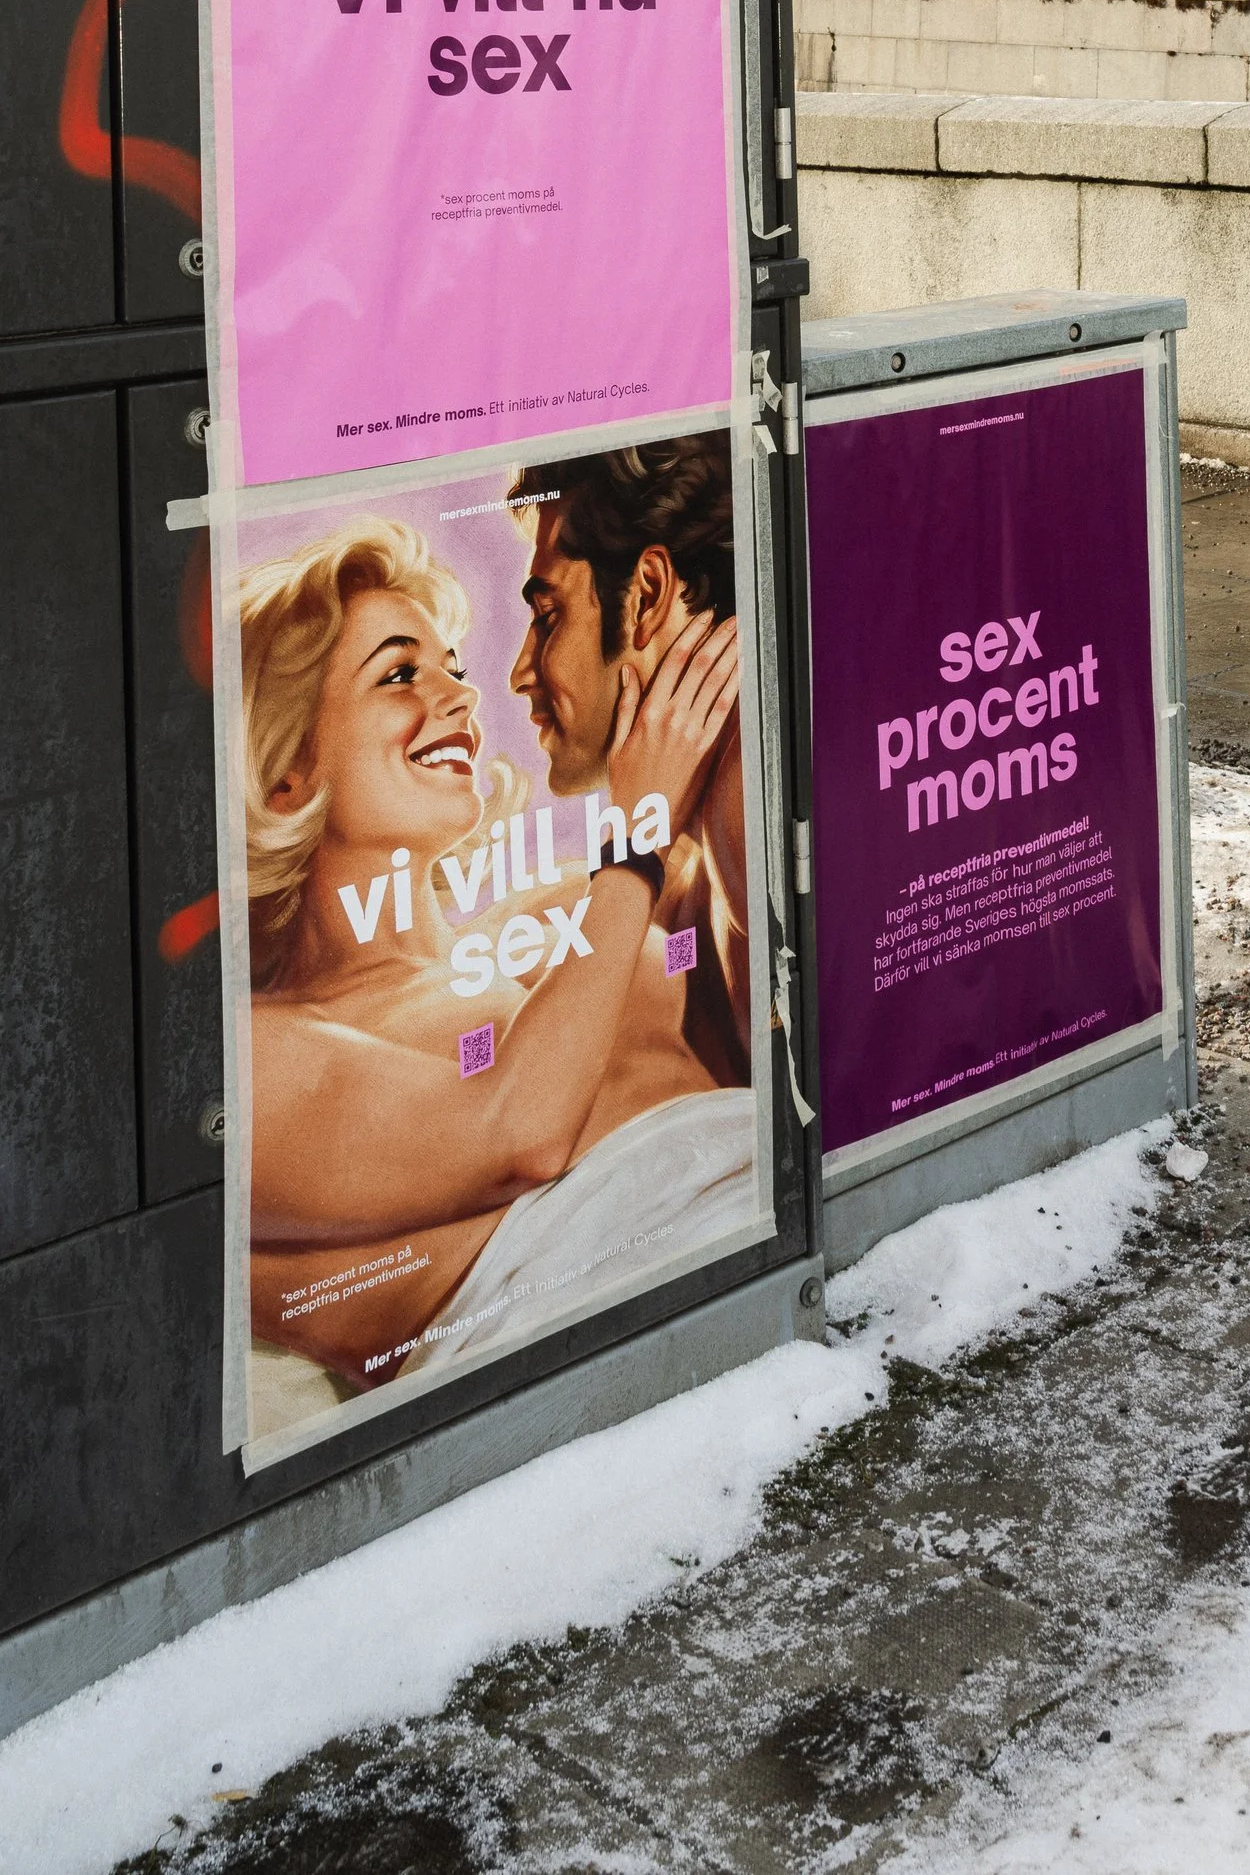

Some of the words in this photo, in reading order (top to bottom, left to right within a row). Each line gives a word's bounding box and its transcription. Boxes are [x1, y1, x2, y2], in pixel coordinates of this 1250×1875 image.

[427, 33, 572, 97] sex
[431, 207, 482, 221] receptfria
[485, 201, 563, 219] preventivmedel.
[465, 190, 505, 205] procent
[508, 189, 540, 200] moms
[543, 186, 555, 200] på
[336, 422, 364, 438] Mer
[367, 419, 393, 433] sex.
[395, 410, 440, 429] Mindre
[444, 406, 487, 422] moms.
[489, 401, 505, 415] Ett
[508, 395, 549, 412] initiativ
[552, 395, 565, 406] av
[567, 386, 607, 404] Natural
[610, 382, 650, 399] Cycles.
[939, 412, 1025, 436] mersexmindremoms.nu
[439, 490, 560, 522] mersexmindremoms.nu
[939, 610, 1043, 683] sex
[877, 644, 1099, 791] procent
[907, 731, 1078, 833] moms
[337, 847, 413, 945] vi
[439, 806, 562, 915] vill
[585, 791, 671, 872] ha
[875, 925, 918, 950] skydda
[921, 913, 942, 931] sig.
[945, 901, 971, 921] Men
[974, 881, 1033, 911] receptfria
[1035, 846, 1113, 893] preventivmedel
[885, 903, 918, 925] Ingen
[921, 892, 943, 910] ska
[945, 876, 989, 903] straffas
[991, 868, 1008, 884] för
[1012, 860, 1033, 878] hur
[1035, 852, 1056, 871] man
[1058, 839, 1086, 861] väljer
[1088, 830, 1103, 848] att
[909, 874, 926, 897] på
[928, 853, 991, 887] receptfria
[993, 815, 1090, 867] preventivmedel!
[449, 896, 594, 998] sex
[873, 956, 892, 971] har
[895, 926, 962, 960] fortfarande
[965, 906, 1017, 934] Sveriges
[1021, 893, 1057, 916] högsta
[1058, 867, 1115, 899] momssats.
[874, 964, 911, 992] Därför
[914, 956, 930, 974] vill
[933, 949, 943, 965] vi
[945, 937, 981, 963] sänka
[983, 920, 1037, 947] momsen
[1039, 910, 1051, 928] till
[1053, 906, 1070, 922] sex
[1073, 884, 1117, 915] procent.
[891, 1094, 912, 1112] Mer
[913, 1088, 932, 1103] sex.
[934, 1070, 964, 1094] Mindre
[966, 1059, 996, 1078] moms.
[995, 1049, 1008, 1064] Ett
[1039, 1035, 1050, 1045] av
[1051, 1021, 1079, 1041] Natural
[1080, 1009, 1107, 1028] Cycles.
[281, 1290, 340, 1321] receptfria
[343, 1253, 432, 1299] preventivmedel.
[310, 1266, 358, 1296] procent
[359, 1253, 394, 1276] moms
[397, 1245, 412, 1263] på
[364, 1350, 392, 1373] Mer
[394, 1336, 422, 1357] sex.
[424, 1314, 473, 1344] Mindre
[475, 1295, 511, 1324] moms.
[513, 1280, 531, 1299] Ett
[535, 1269, 577, 1295] initiativ
[580, 1262, 593, 1276] av
[594, 1237, 631, 1265] Natural
[634, 1223, 675, 1247] Cycles.
